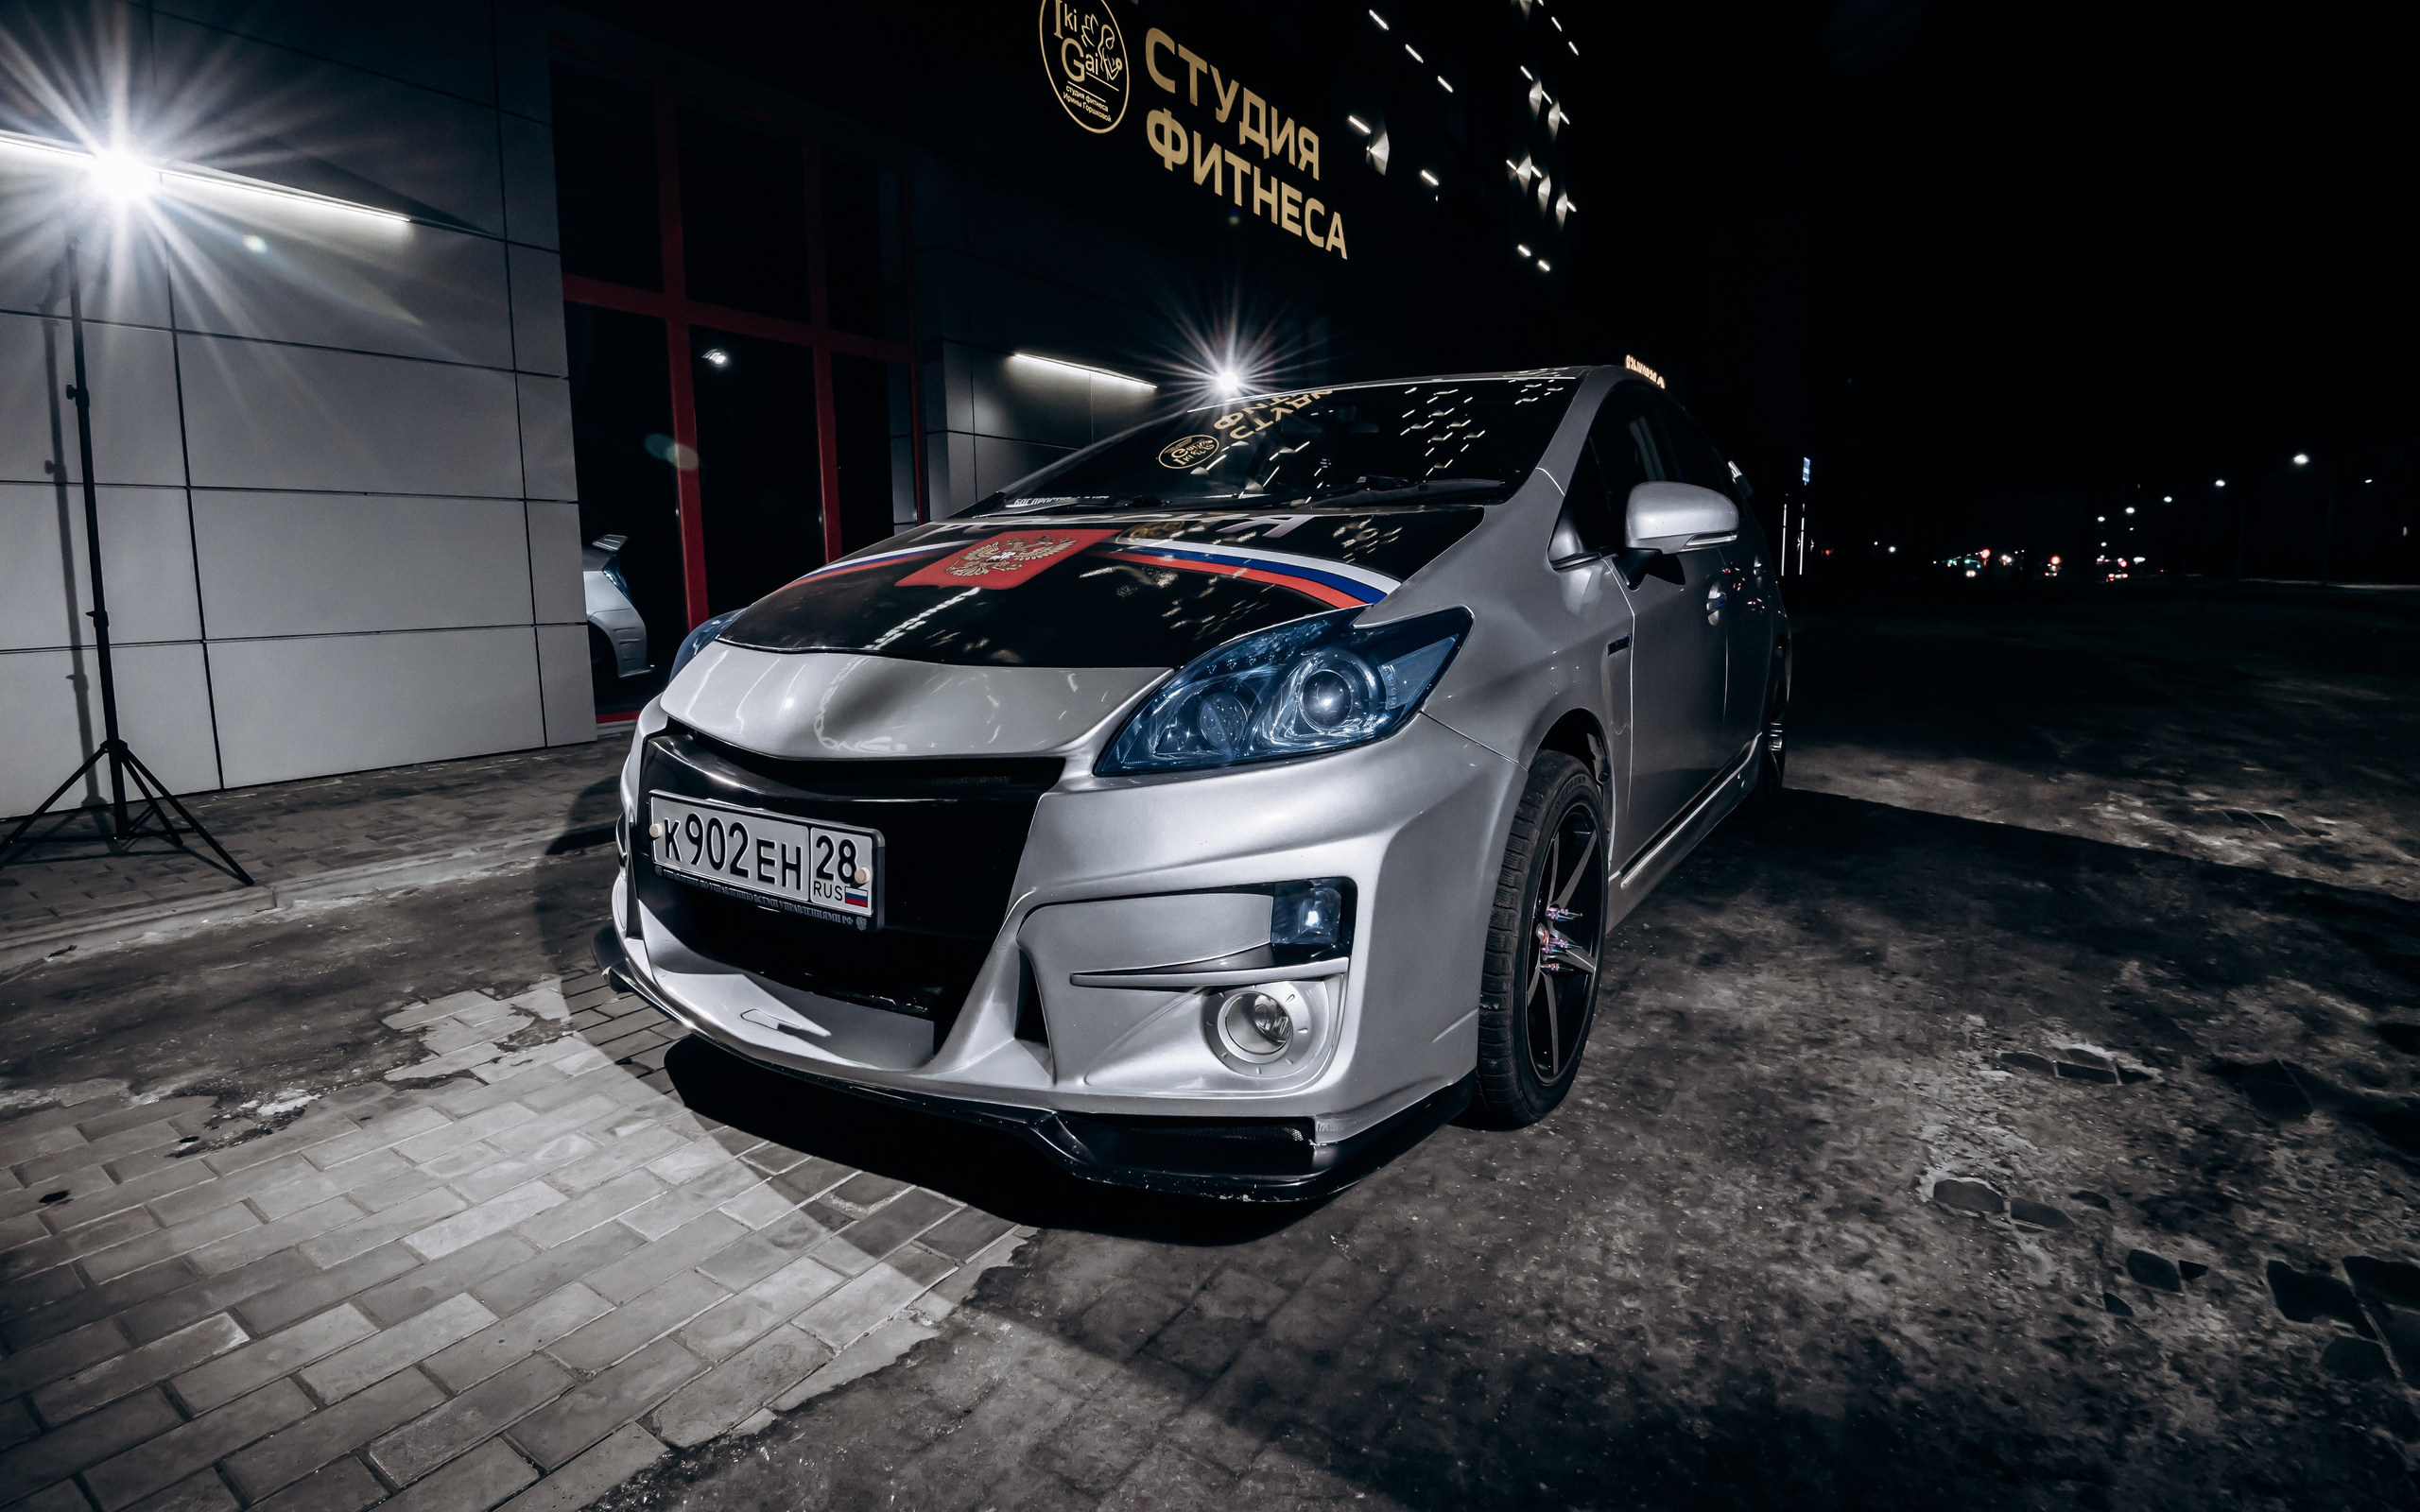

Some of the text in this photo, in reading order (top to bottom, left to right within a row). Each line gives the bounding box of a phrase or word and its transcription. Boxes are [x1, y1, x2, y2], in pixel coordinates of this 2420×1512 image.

[1062, 38, 1098, 82] Gai
[1065, 85, 1085, 100] студия
[1145, 27, 1319, 180] СТУДИЯ
[1146, 108, 1348, 260] ФИТНЕСА
[816, 835, 857, 884] 28
[813, 881, 843, 902] RUS
